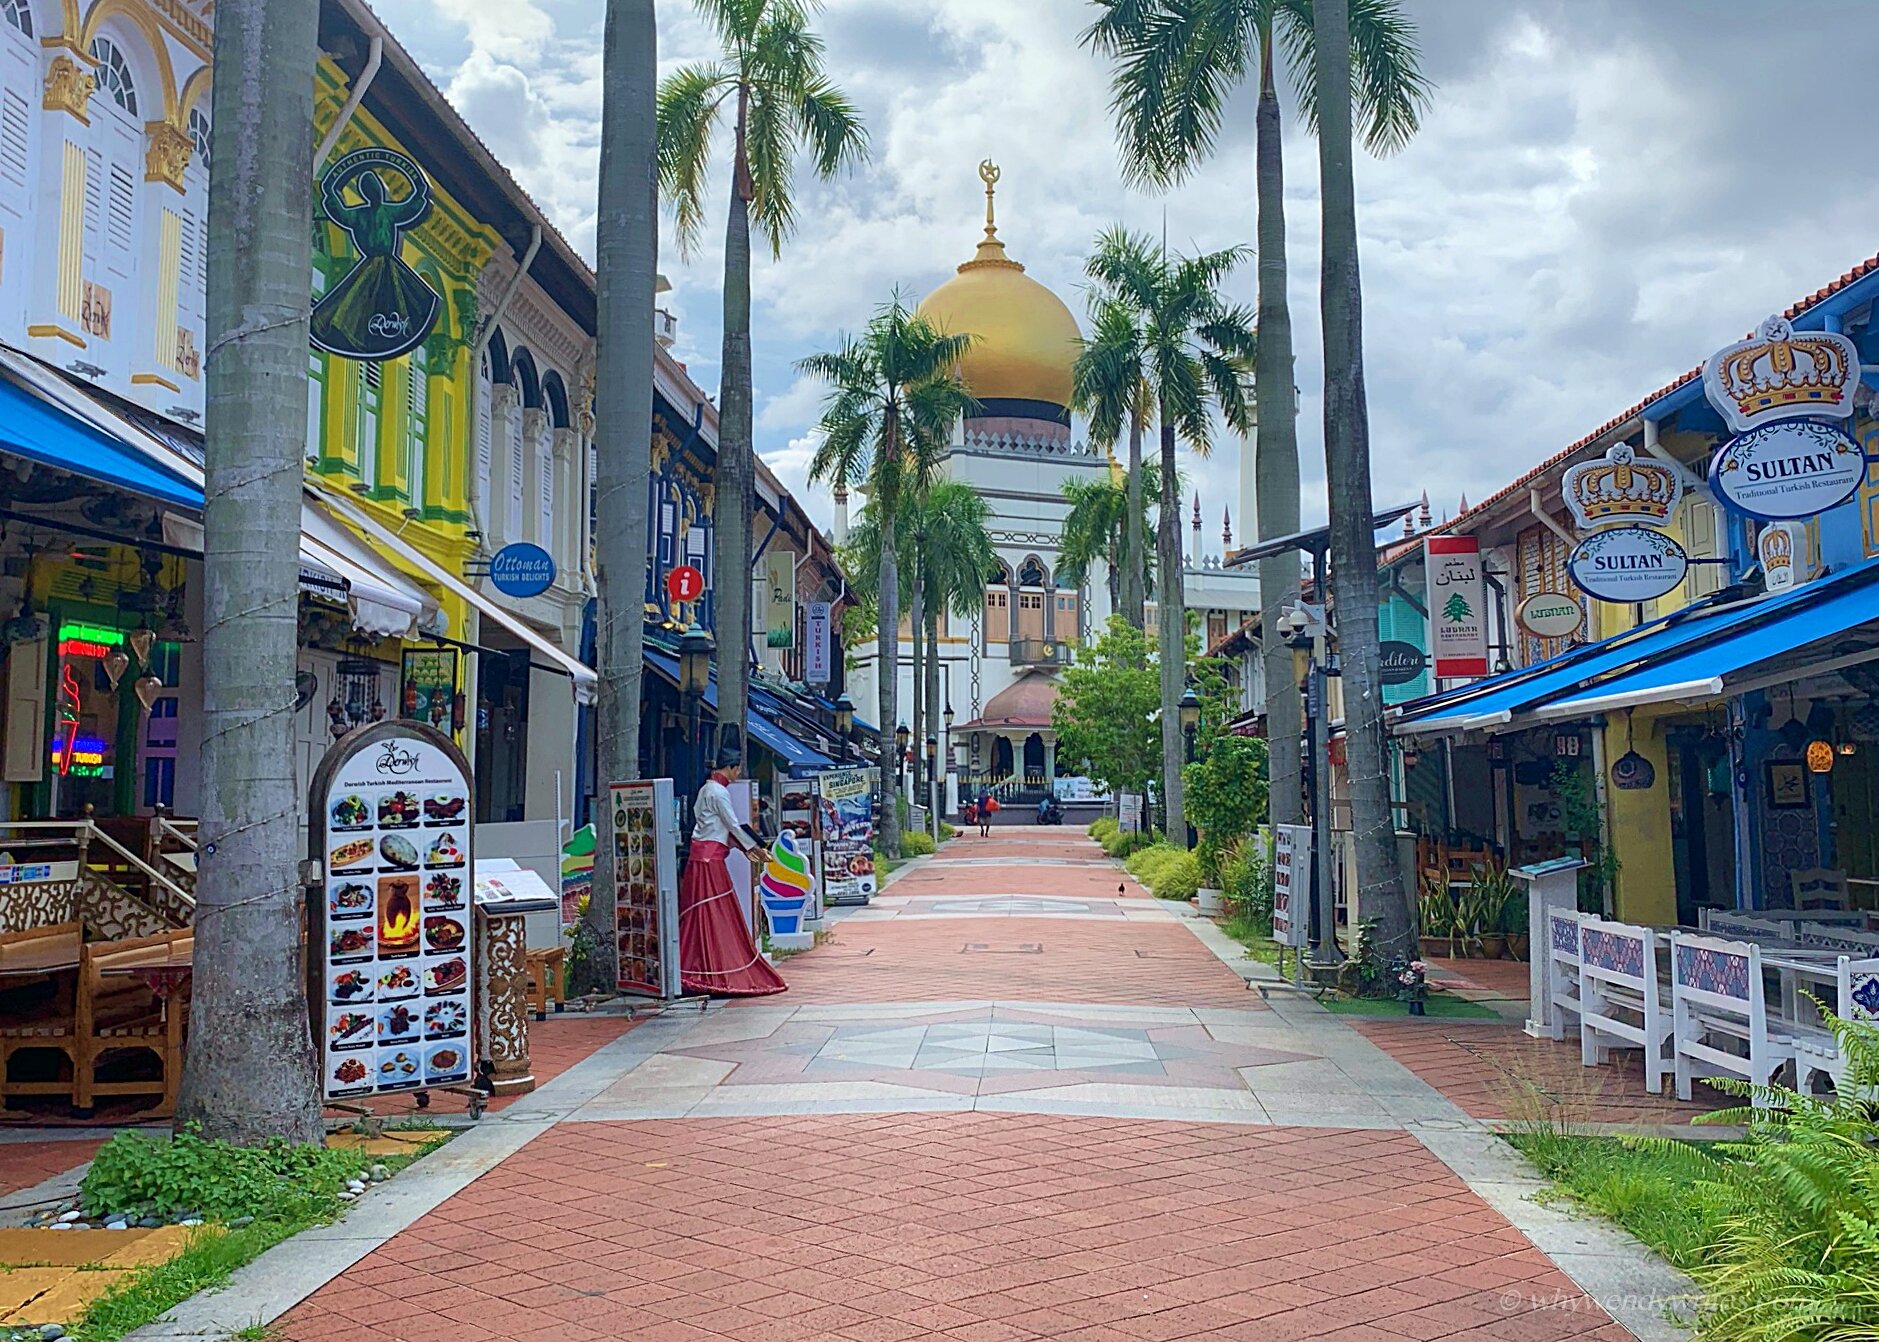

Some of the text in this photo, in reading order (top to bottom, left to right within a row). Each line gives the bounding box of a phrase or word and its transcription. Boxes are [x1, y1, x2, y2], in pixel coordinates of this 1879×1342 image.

[331, 151, 419, 181] AUTHENTIC TURKISH
[1746, 452, 1835, 482] SULTAN
[1735, 476, 1855, 501] Traditional Turkish Restaurant
[494, 553, 549, 571] Ottoman
[1595, 554, 1663, 571] SULTAN
[494, 572, 550, 581] TURKISH DELIGHTS
[1436, 568, 1476, 586] لبنان
[1644, 573, 1677, 581] Restaurant
[773, 588, 792, 603] Padi
[814, 621, 822, 669] TURKISH
[829, 773, 864, 789] SINGAPORE
